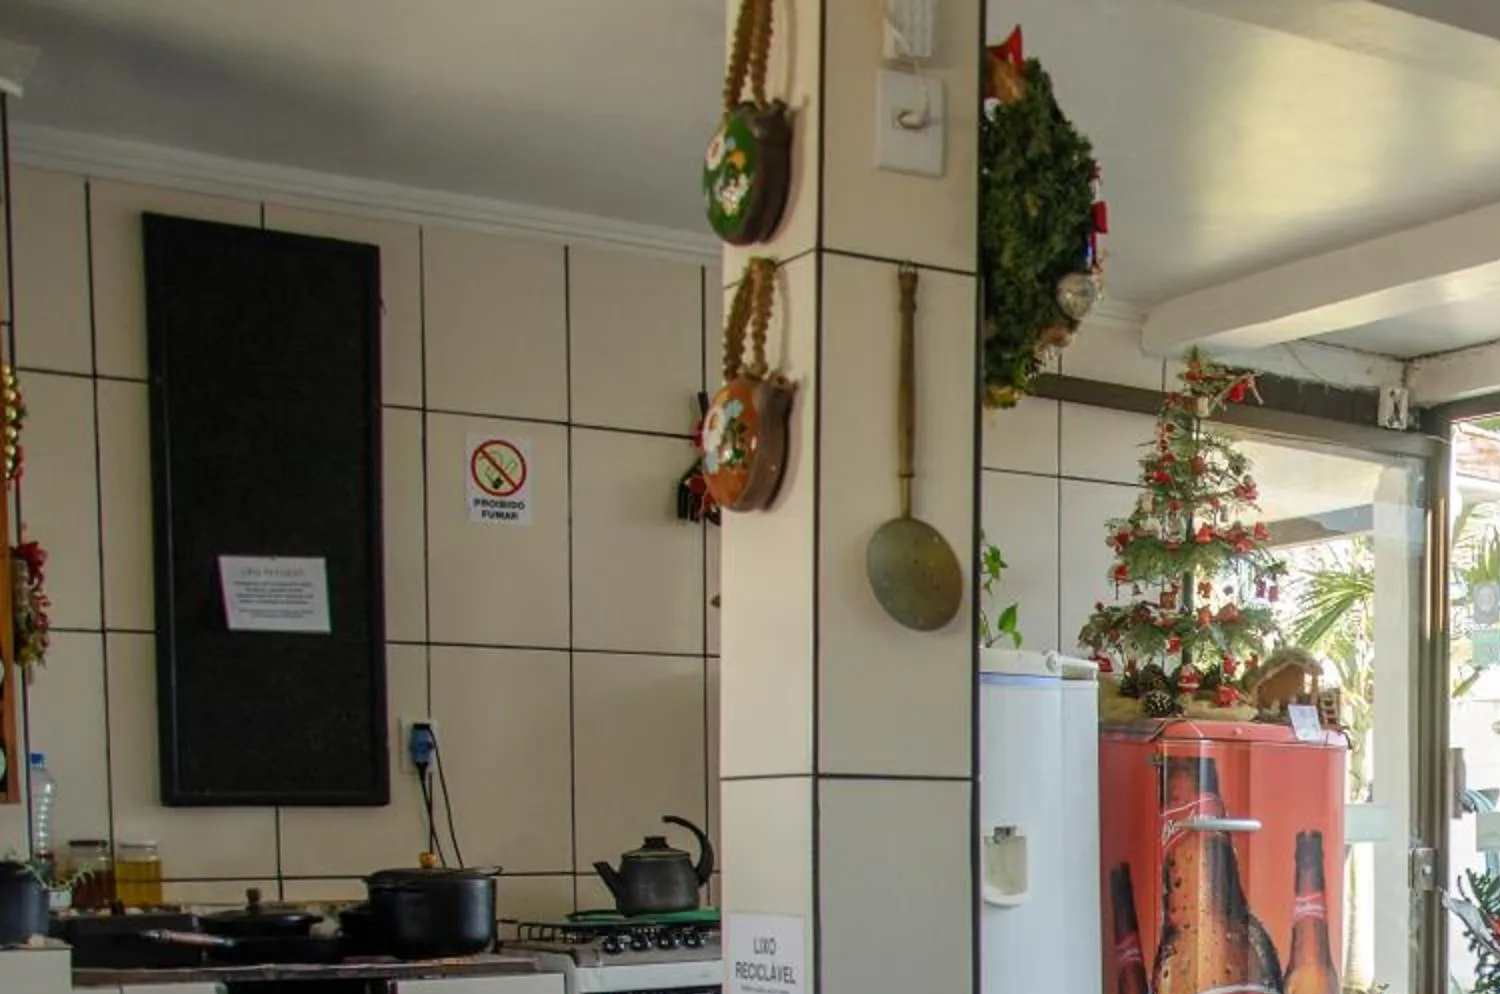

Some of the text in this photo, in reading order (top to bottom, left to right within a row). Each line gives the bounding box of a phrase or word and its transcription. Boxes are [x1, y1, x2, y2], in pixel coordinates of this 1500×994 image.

[473, 498, 526, 510] PROIBIDO
[481, 509, 519, 520] FUMAR
[753, 937, 776, 955] LIXO
